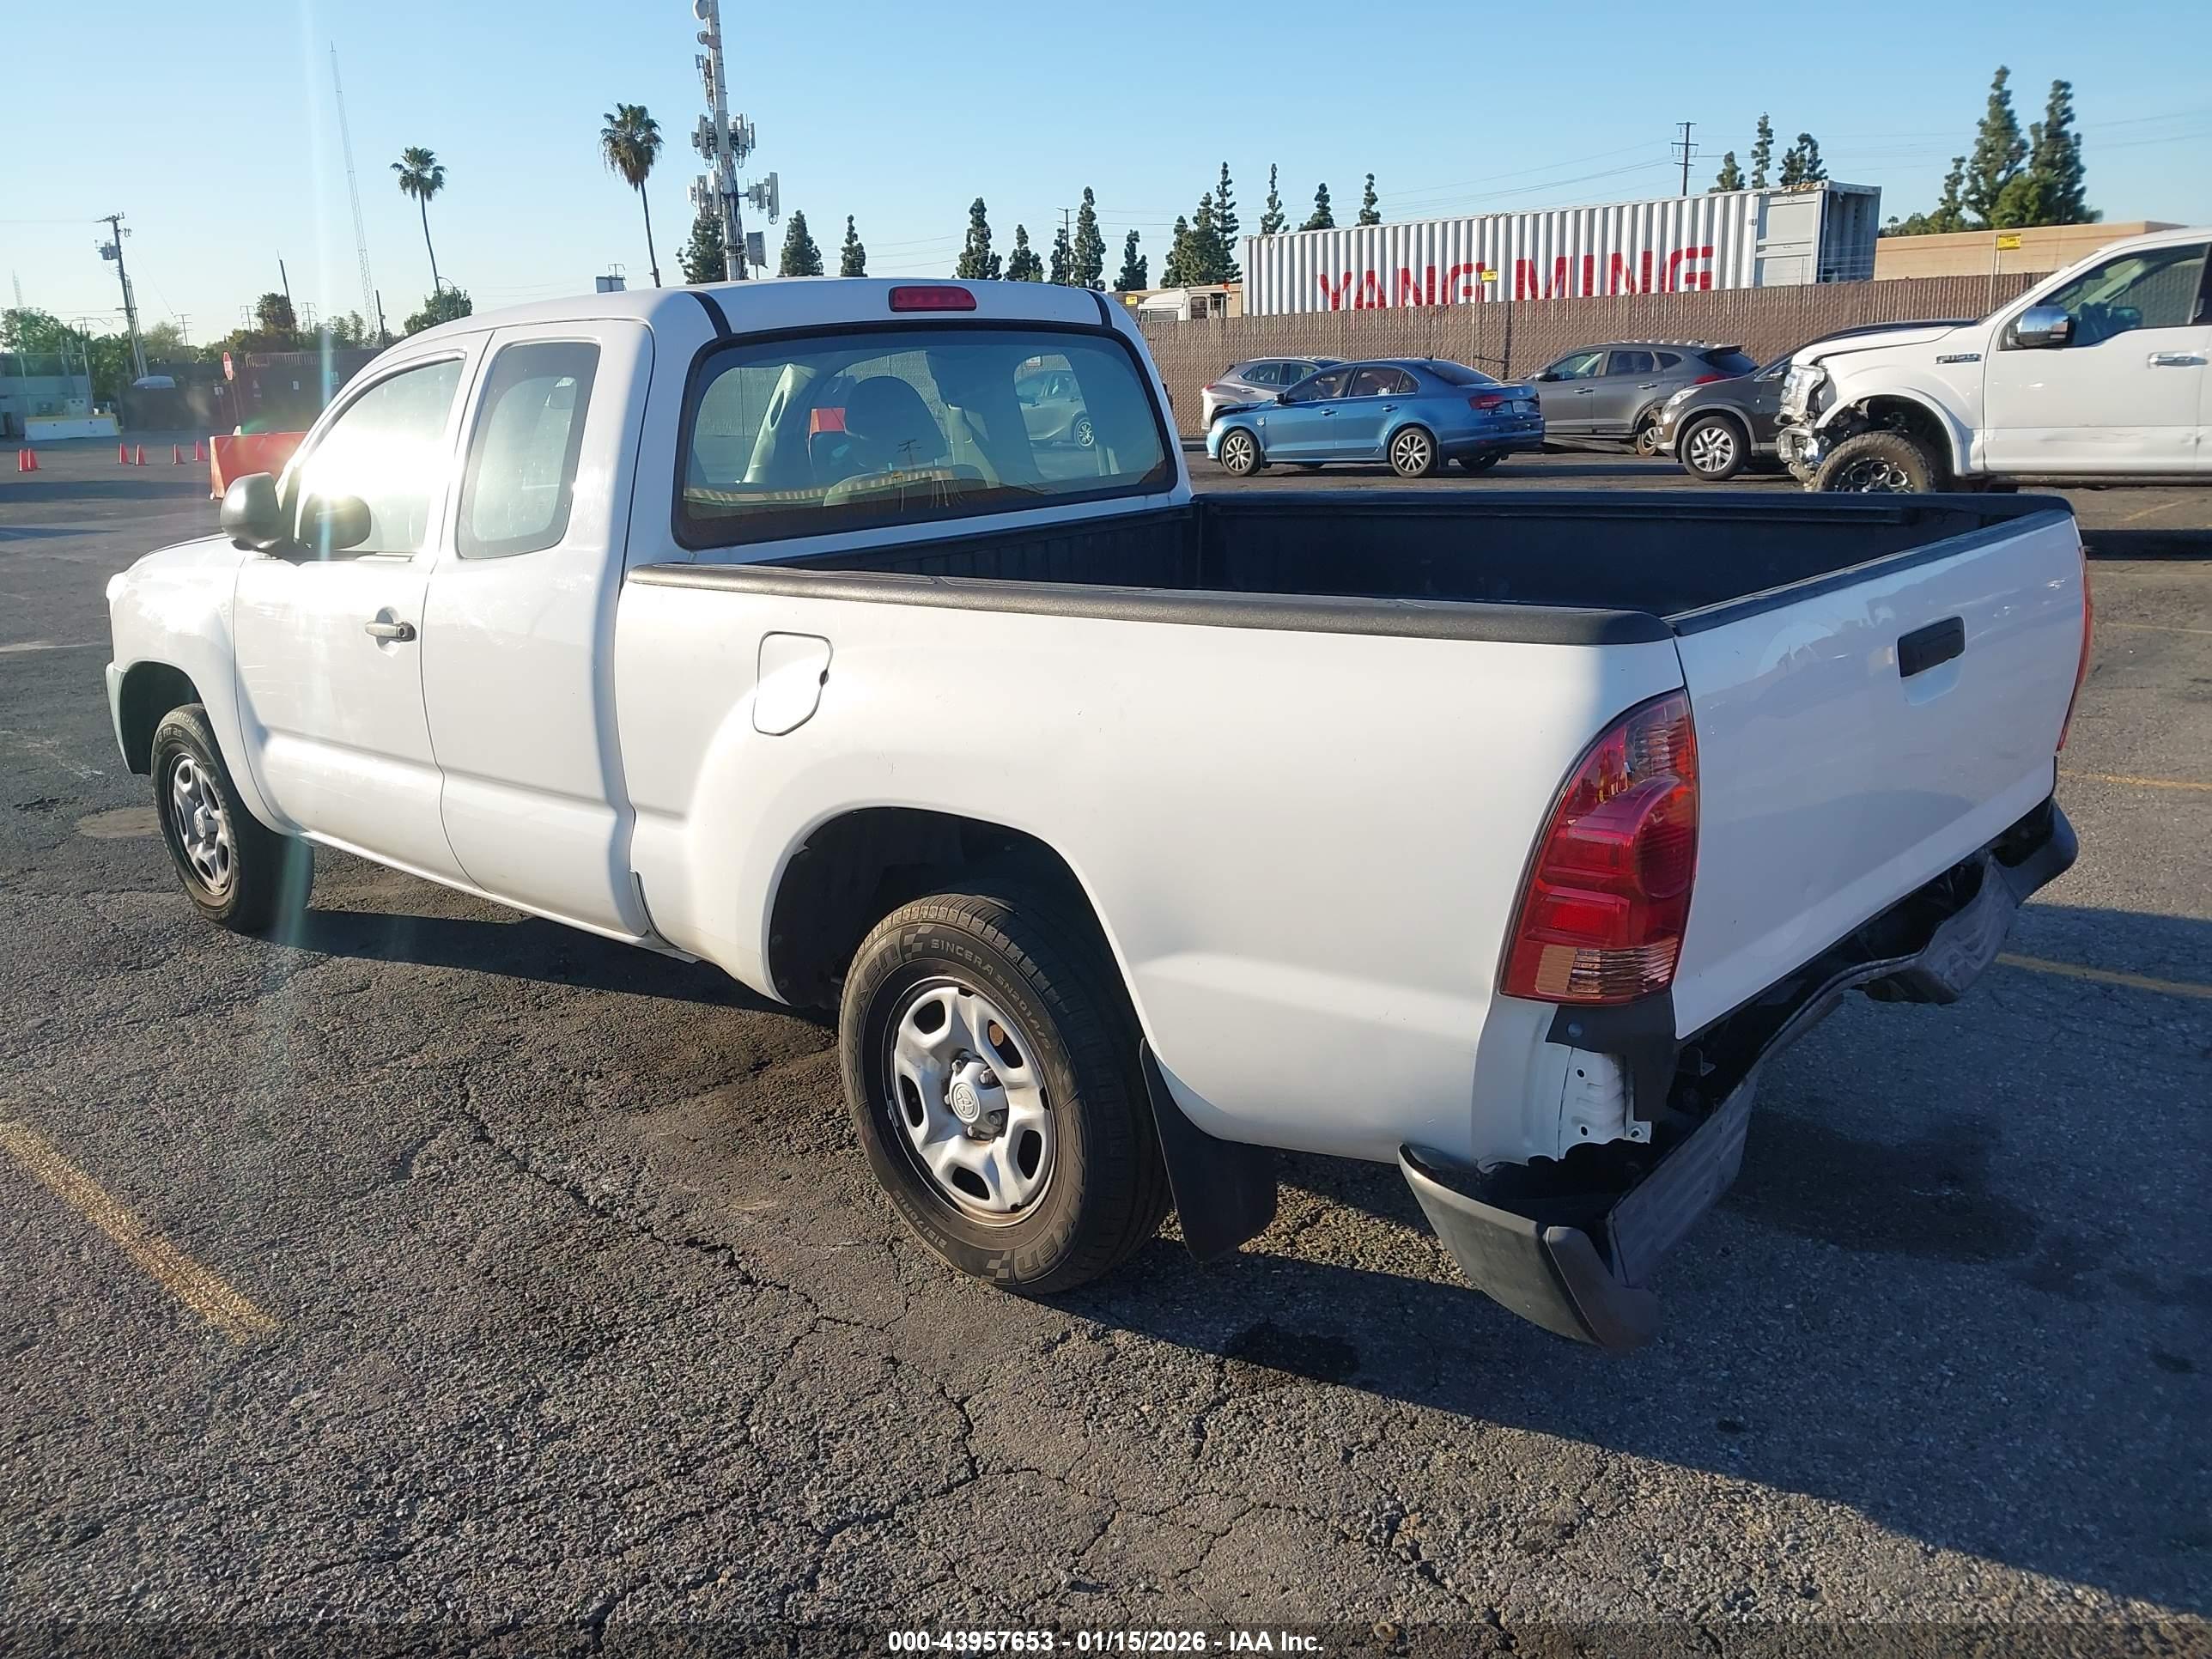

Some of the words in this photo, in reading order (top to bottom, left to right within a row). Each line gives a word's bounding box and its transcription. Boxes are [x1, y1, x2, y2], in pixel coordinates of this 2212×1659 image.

[1318, 261, 1486, 311] YANG
[1516, 246, 1713, 301] MING
[931, 939, 994, 975] SINCERA
